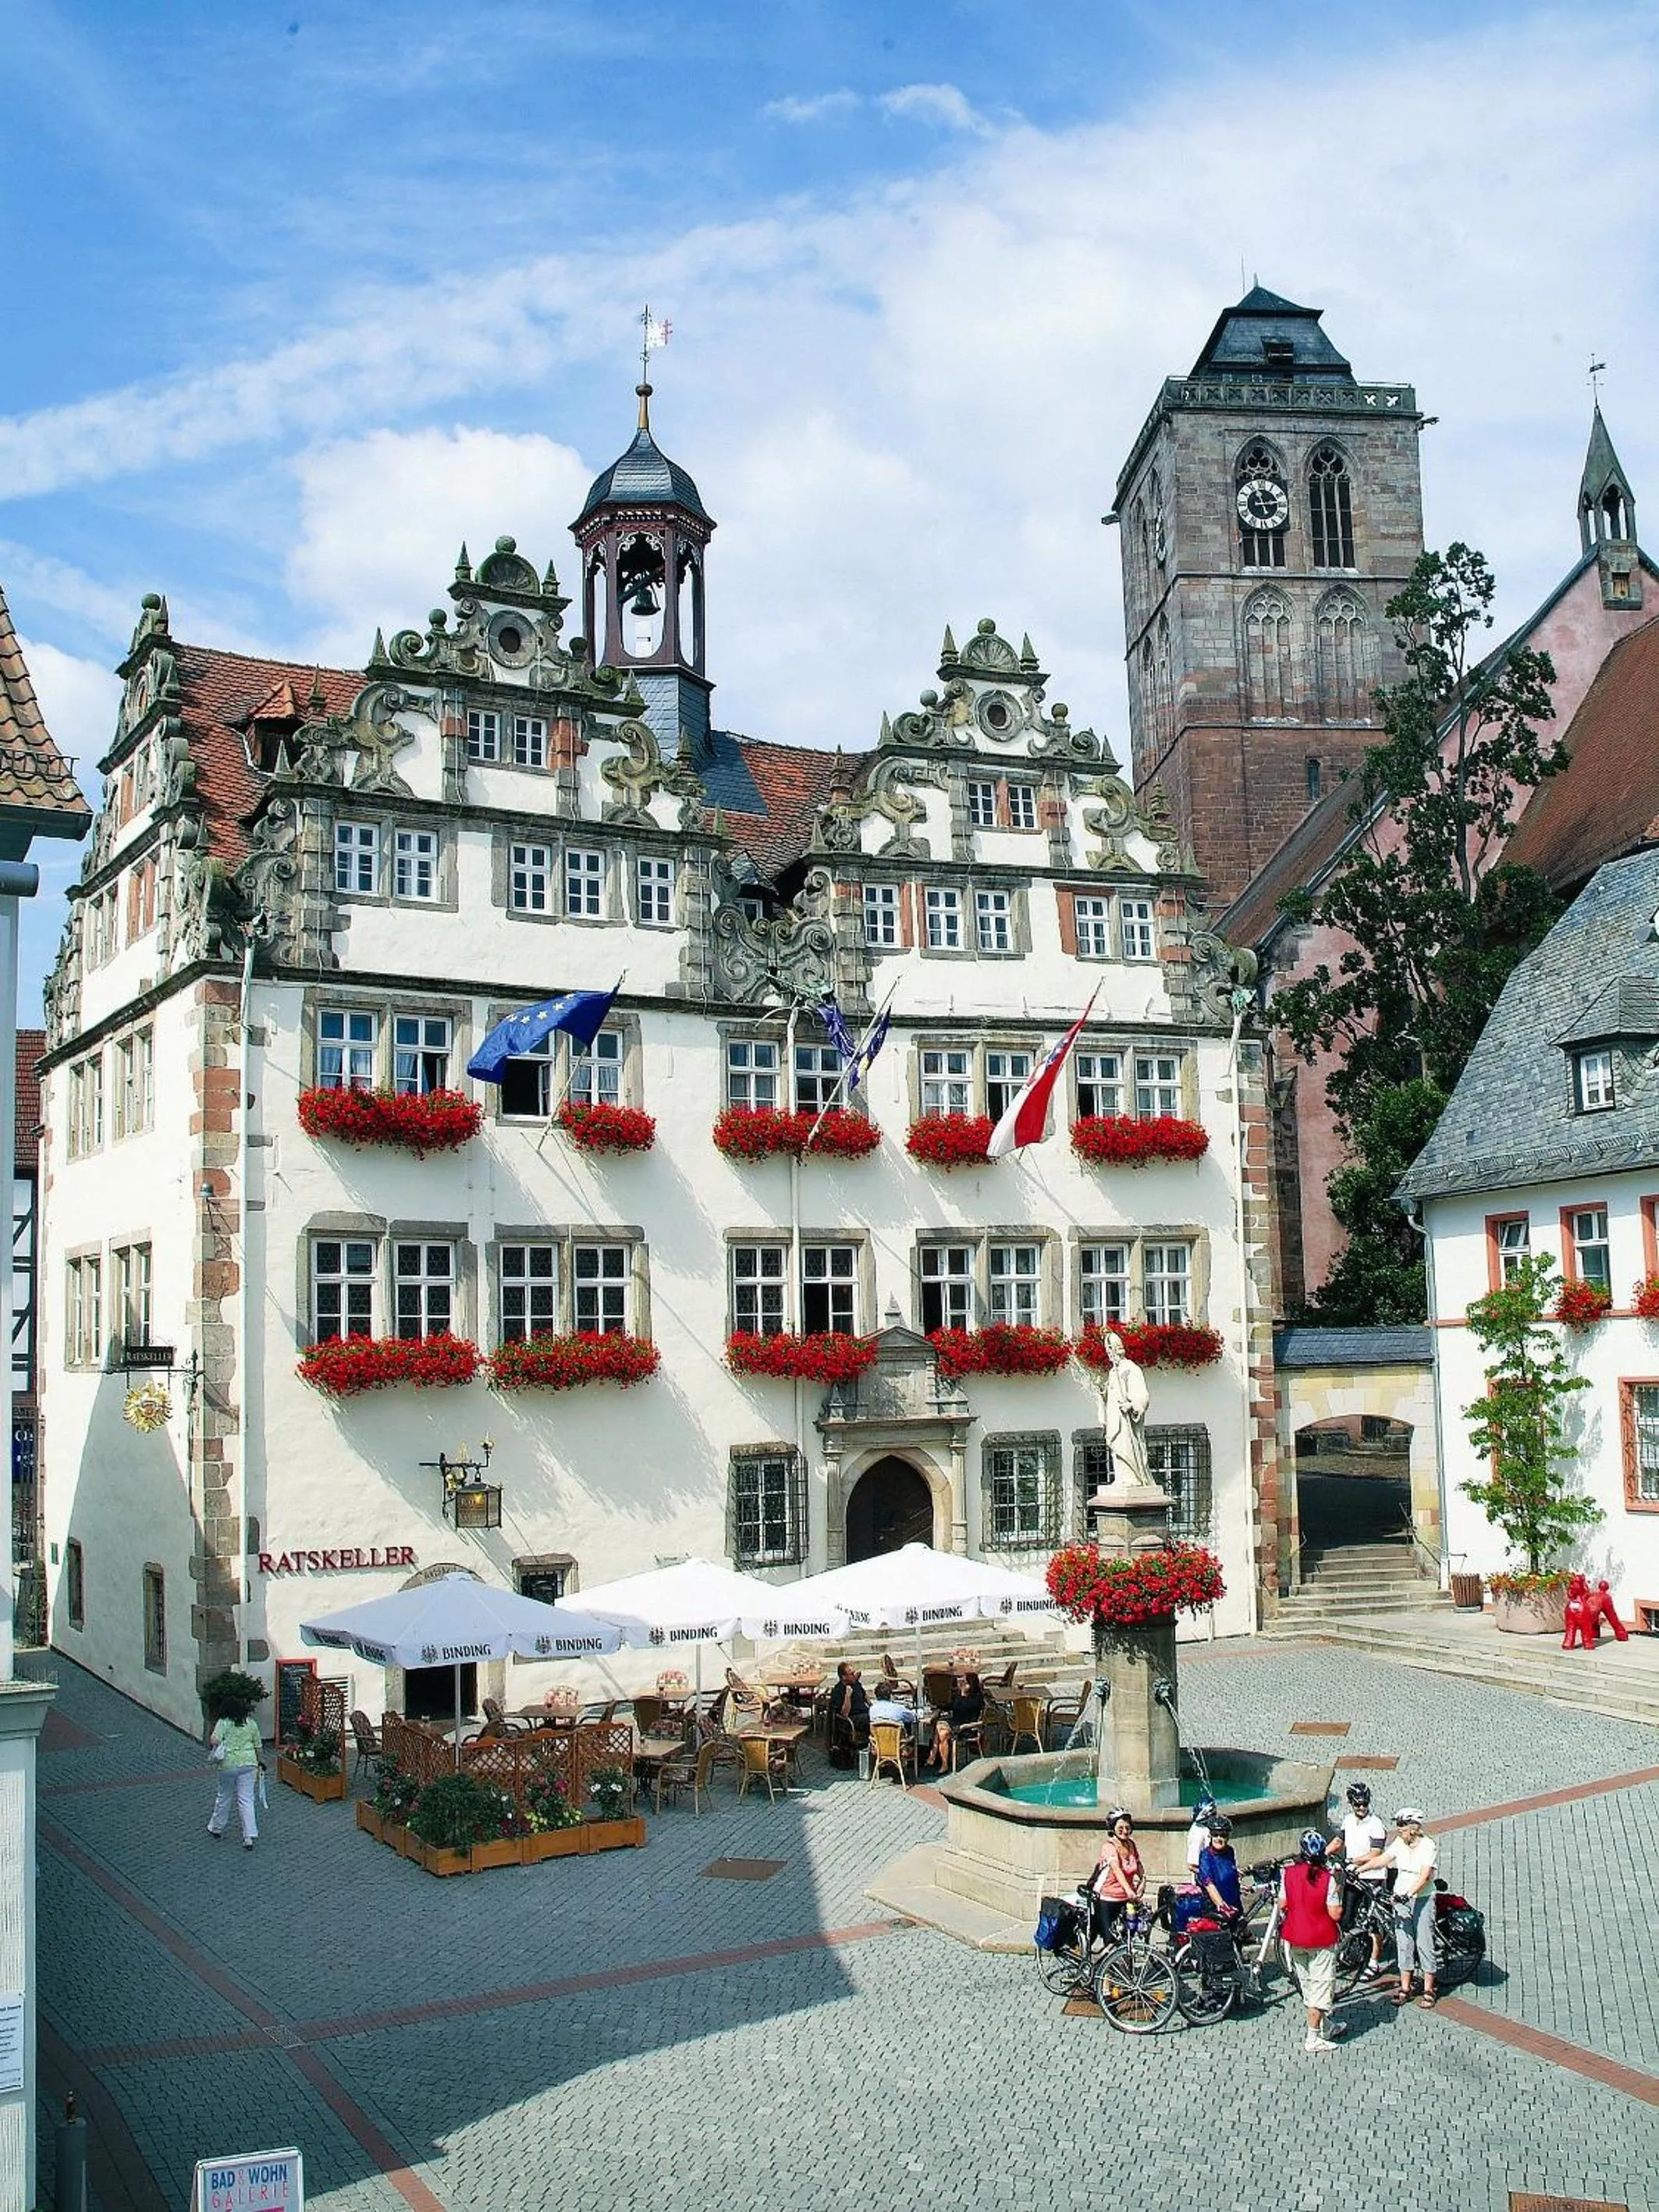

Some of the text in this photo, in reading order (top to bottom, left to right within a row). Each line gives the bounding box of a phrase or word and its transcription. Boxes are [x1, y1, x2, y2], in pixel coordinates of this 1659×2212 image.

[258, 1546, 415, 1573] RATSKELLER
[922, 1606, 962, 1621] BINDING
[670, 1626, 718, 1642] BINDING
[783, 1623, 830, 1635] BINDING
[442, 1644, 491, 1660] BINDING
[556, 1638, 602, 1651] BINDING
[211, 2171, 235, 2189] BAD
[249, 2164, 287, 2184] WOHN
[211, 2181, 289, 2208] GALERIE
